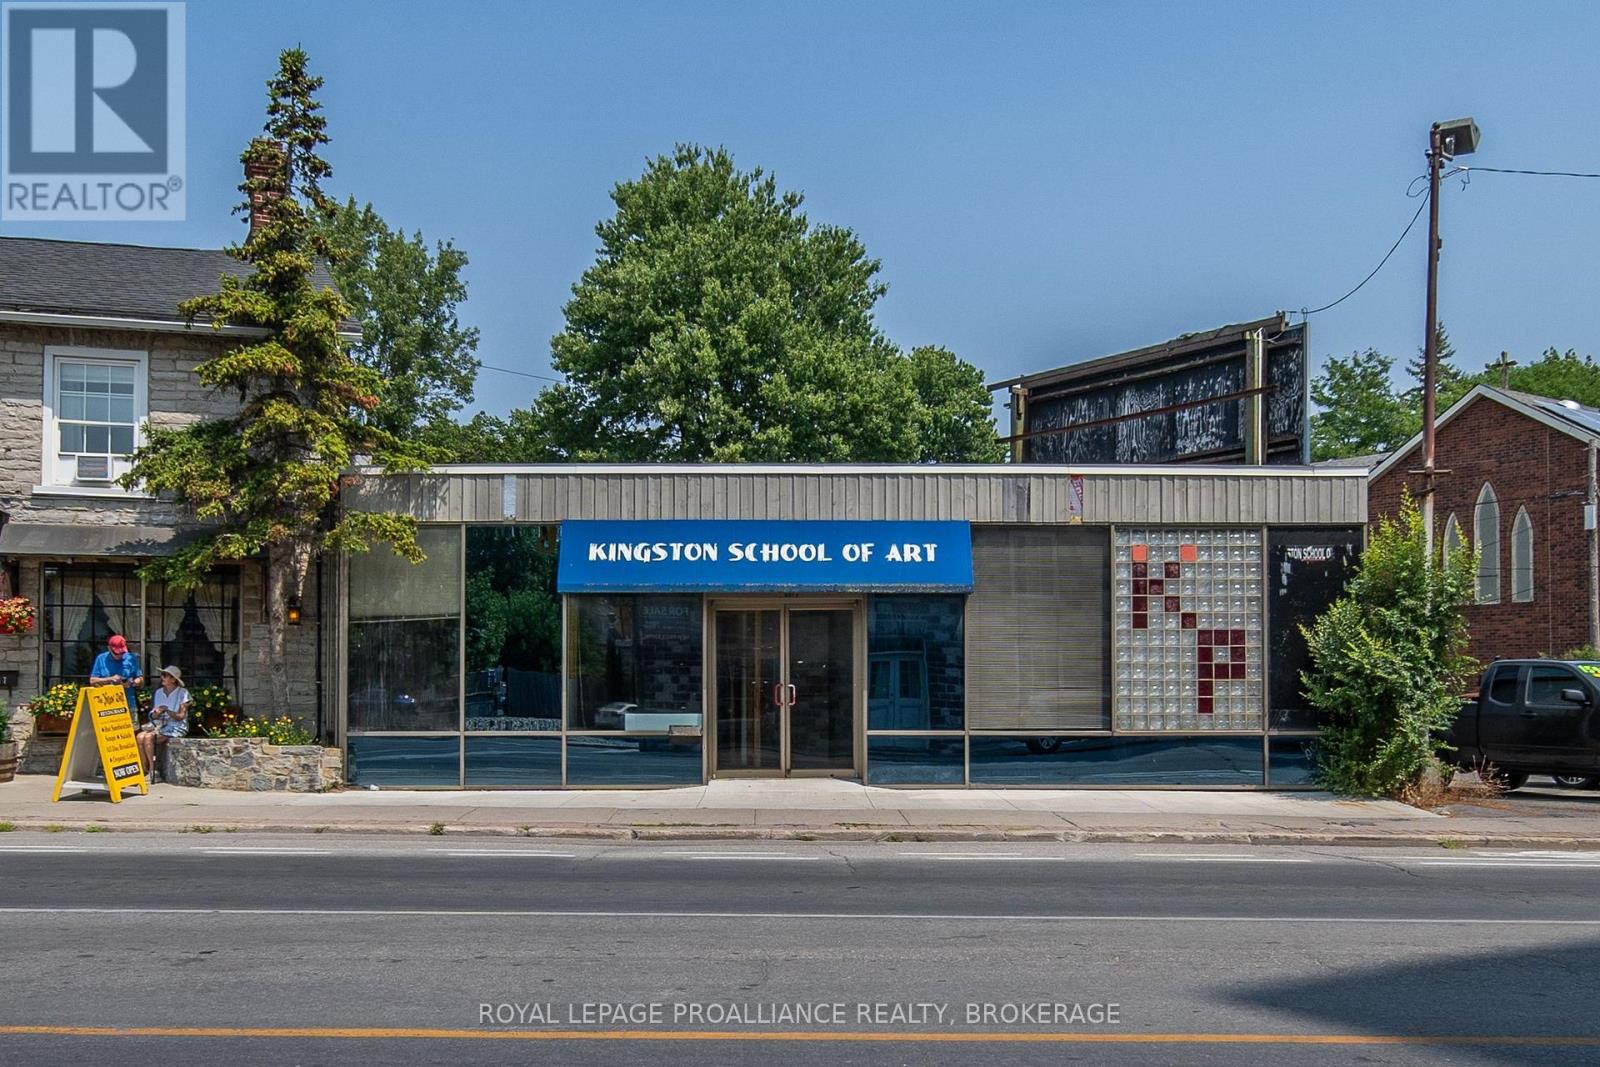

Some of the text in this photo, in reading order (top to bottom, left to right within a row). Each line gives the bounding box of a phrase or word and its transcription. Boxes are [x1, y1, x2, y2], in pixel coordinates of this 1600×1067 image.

[589, 543, 937, 562] KINGSTON SCHOOL OF ART
[125, 764, 139, 775] OPEN
